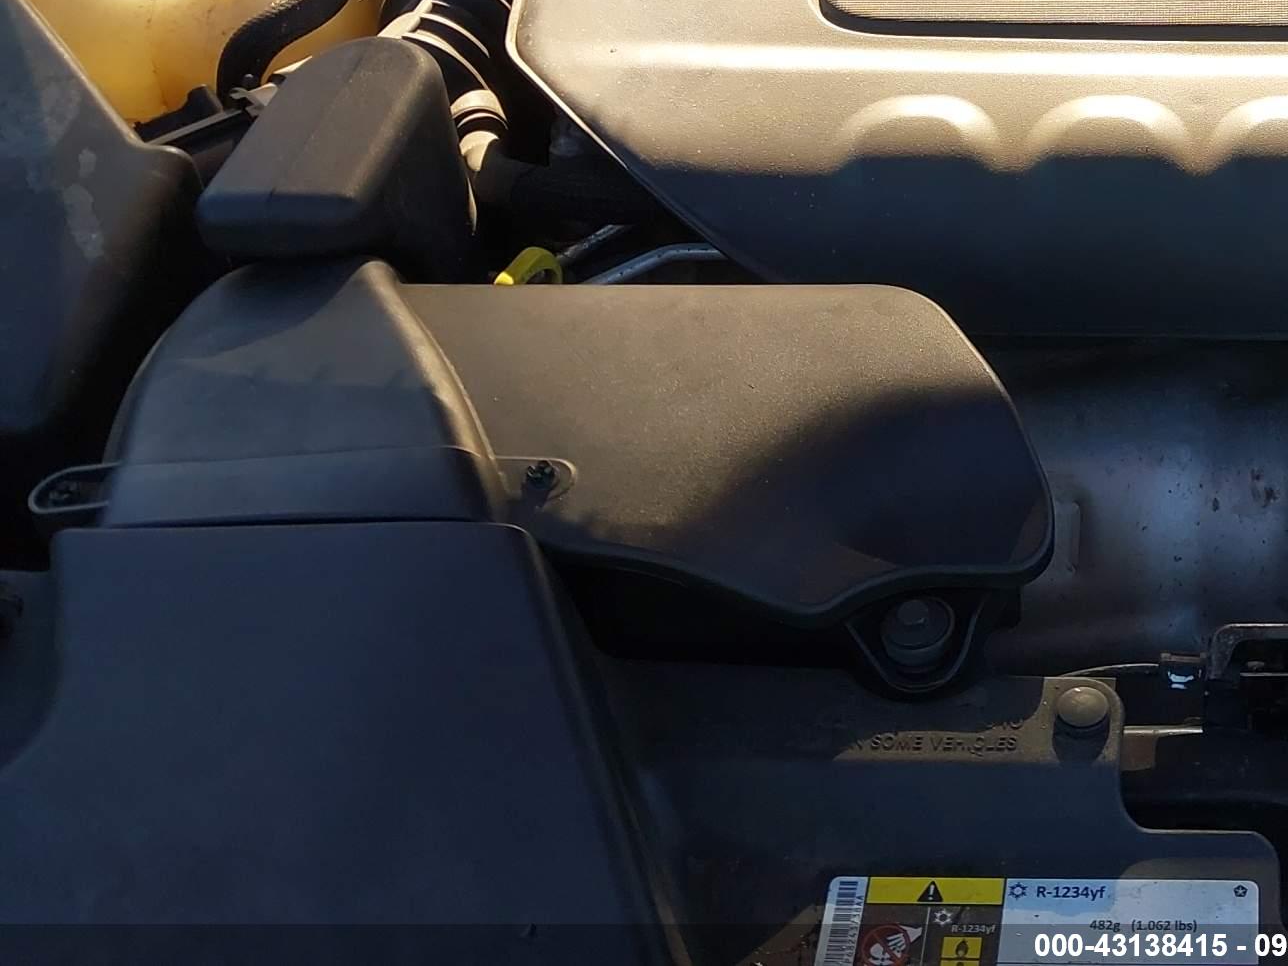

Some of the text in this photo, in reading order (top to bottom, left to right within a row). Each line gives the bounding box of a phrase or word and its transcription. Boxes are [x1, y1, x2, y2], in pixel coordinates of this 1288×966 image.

[870, 733, 924, 752] SOME
[1036, 885, 1107, 900] R-1234yf
[951, 923, 996, 935] R-1234yf
[1089, 919, 1198, 933] 482g (1.062 lbs)
